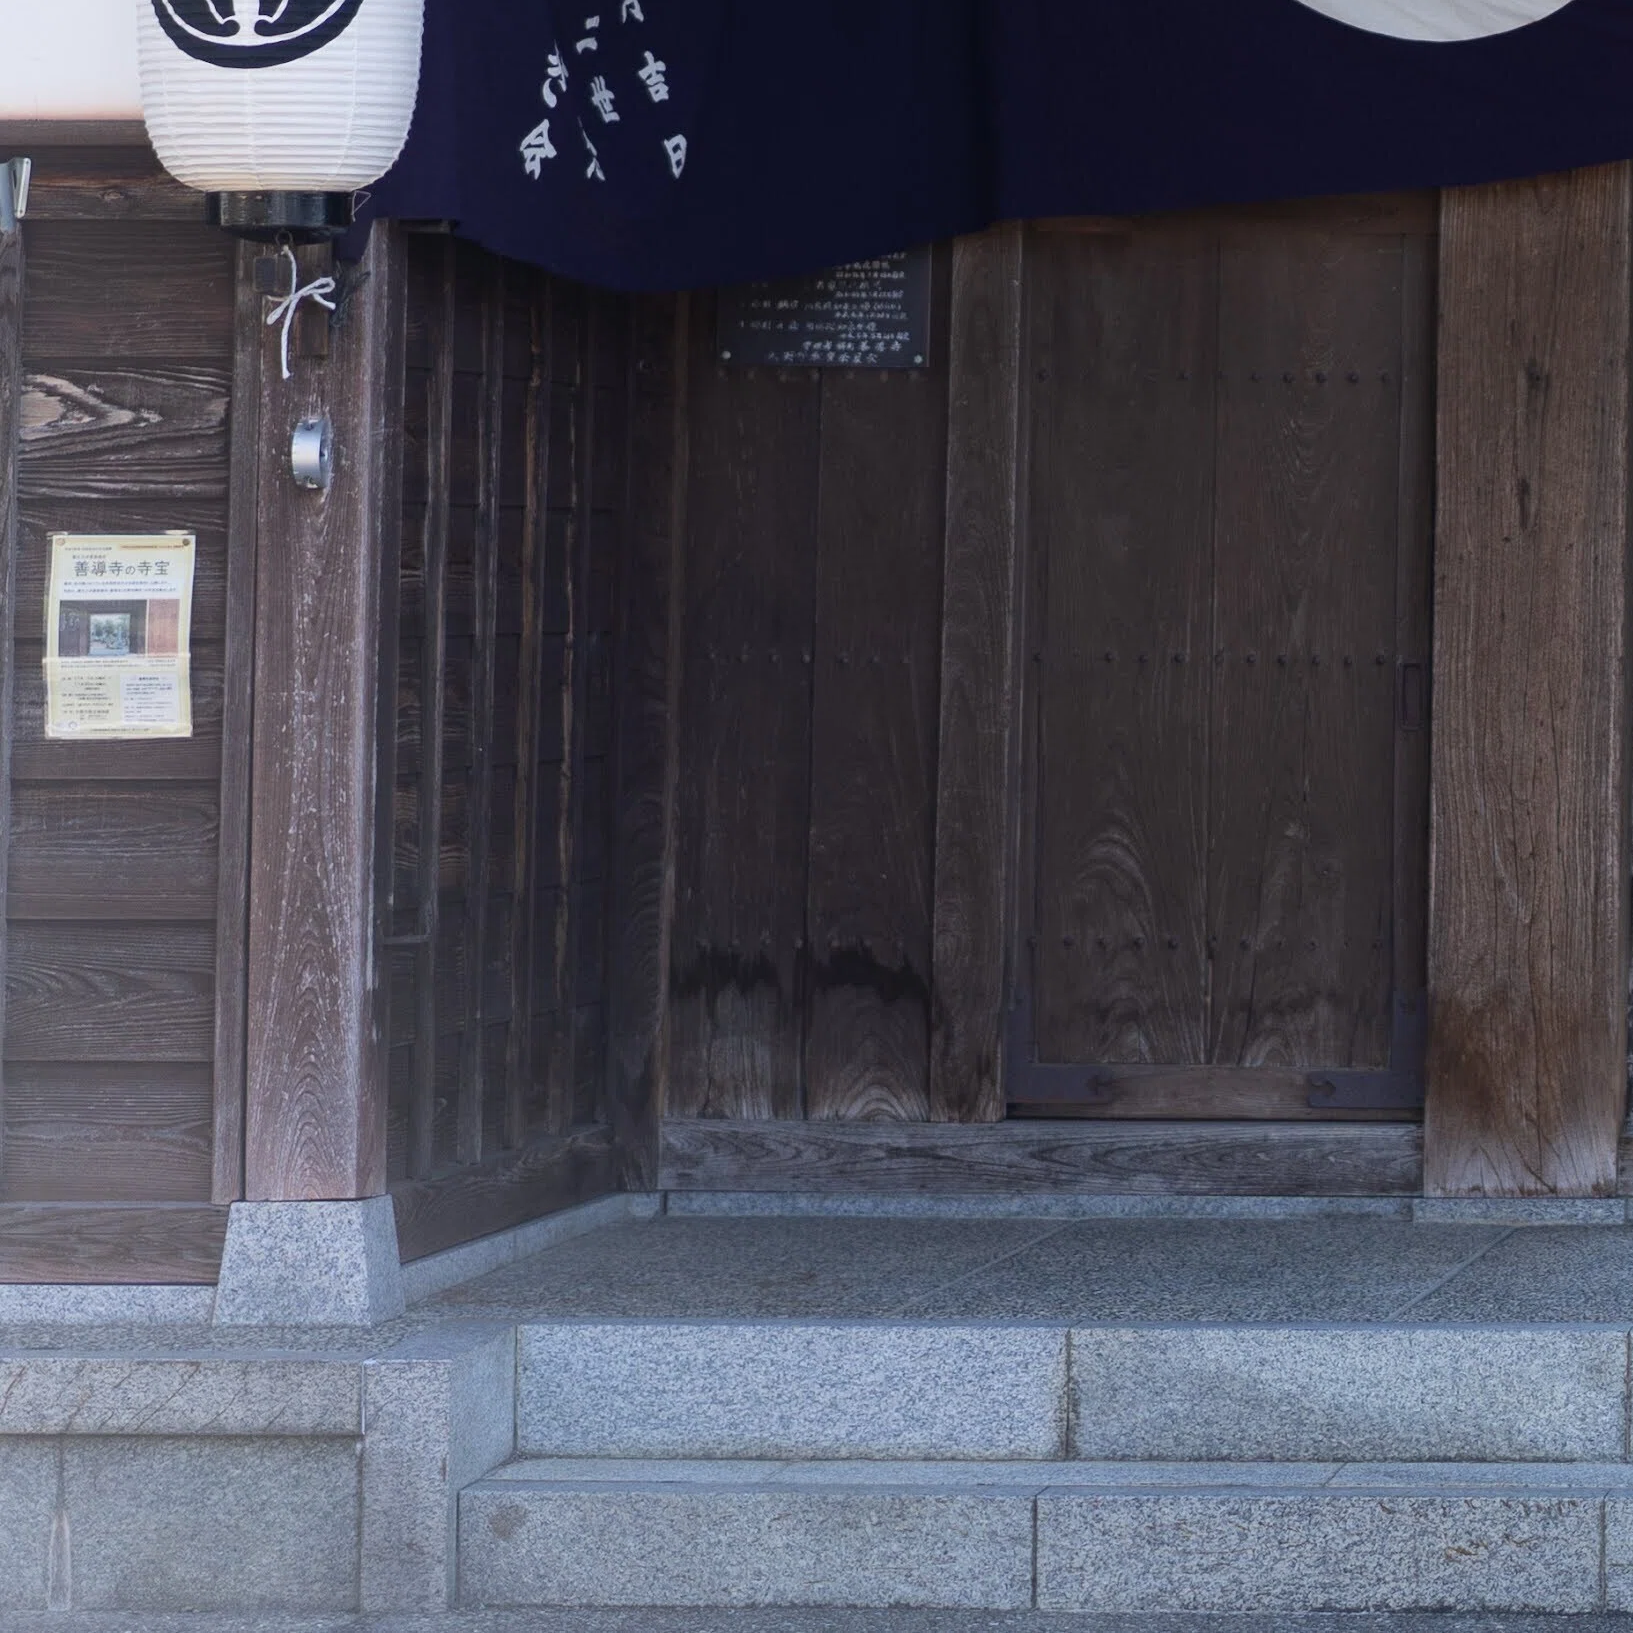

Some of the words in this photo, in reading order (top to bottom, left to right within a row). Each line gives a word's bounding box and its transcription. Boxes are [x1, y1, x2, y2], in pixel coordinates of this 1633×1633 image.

[74, 560, 171, 577] 善導寺の寺宝
